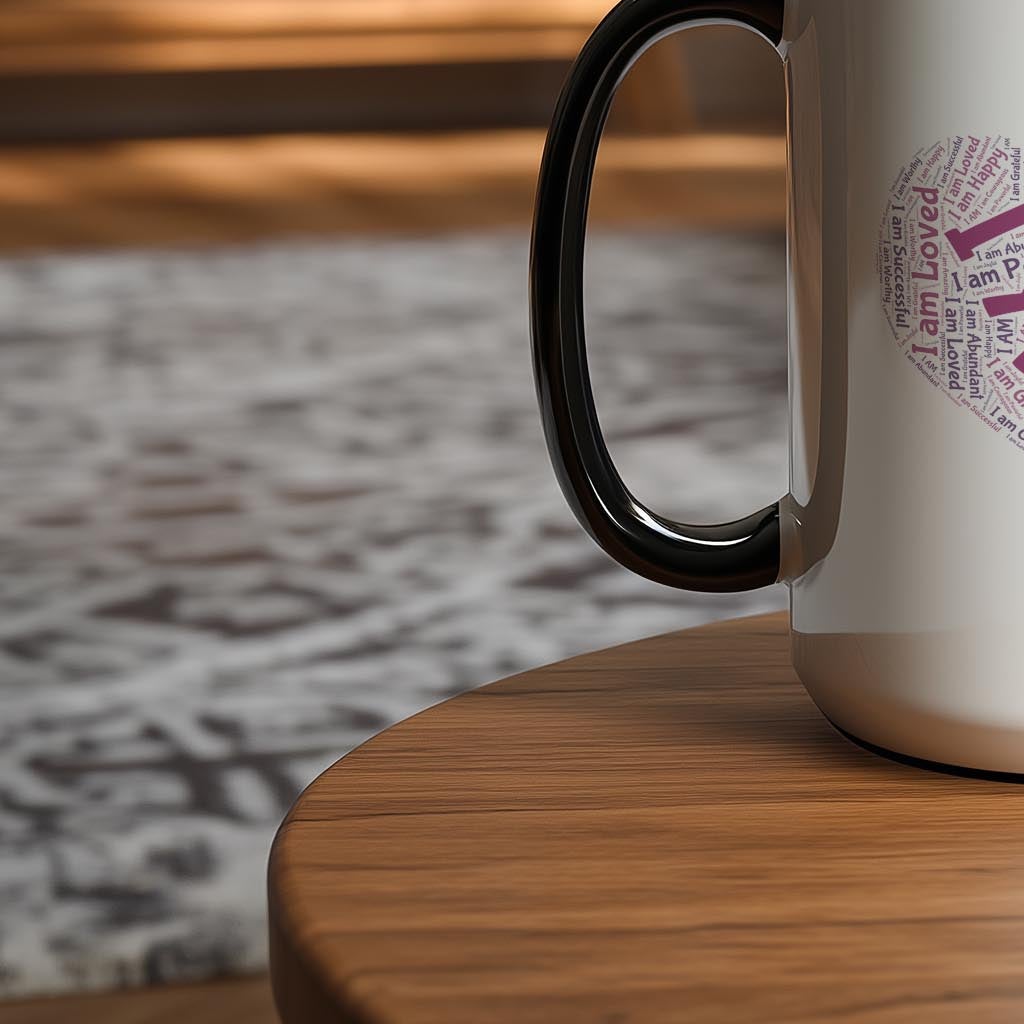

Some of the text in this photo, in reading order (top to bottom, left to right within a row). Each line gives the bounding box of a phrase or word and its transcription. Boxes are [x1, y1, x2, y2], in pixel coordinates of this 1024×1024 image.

[944, 136, 964, 172] Successful
[1010, 147, 1021, 181] Grateful
[897, 185, 906, 195] am
[903, 157, 923, 184] Worthy
[940, 172, 949, 184] am
[943, 135, 980, 205] I am Loved
[948, 147, 1009, 220] I am Happy
[1012, 184, 1020, 196] am
[892, 216, 902, 240] am
[912, 186, 939, 281] Loved
[1015, 231, 1024, 239] am
[884, 248, 890, 262] am
[976, 250, 983, 261] I
[985, 249, 1002, 259] am
[884, 266, 892, 303] Worthy
[893, 245, 910, 328] Successful
[952, 272, 963, 292] I
[968, 269, 1001, 288] am
[920, 292, 940, 336] am
[945, 308, 957, 332] am
[966, 309, 976, 329] am
[985, 324, 993, 335] am
[996, 318, 1013, 344] AM
[912, 344, 938, 356] I
[984, 337, 993, 358] Happy
[907, 355, 916, 363] am
[915, 362, 940, 387] Abundant
[925, 360, 938, 372] AM
[947, 338, 966, 390] Loved
[967, 333, 984, 399] Abundant
[986, 357, 1000, 368] I
[993, 369, 1015, 390] am
[990, 406, 1001, 417] I
[997, 415, 1017, 432] am
